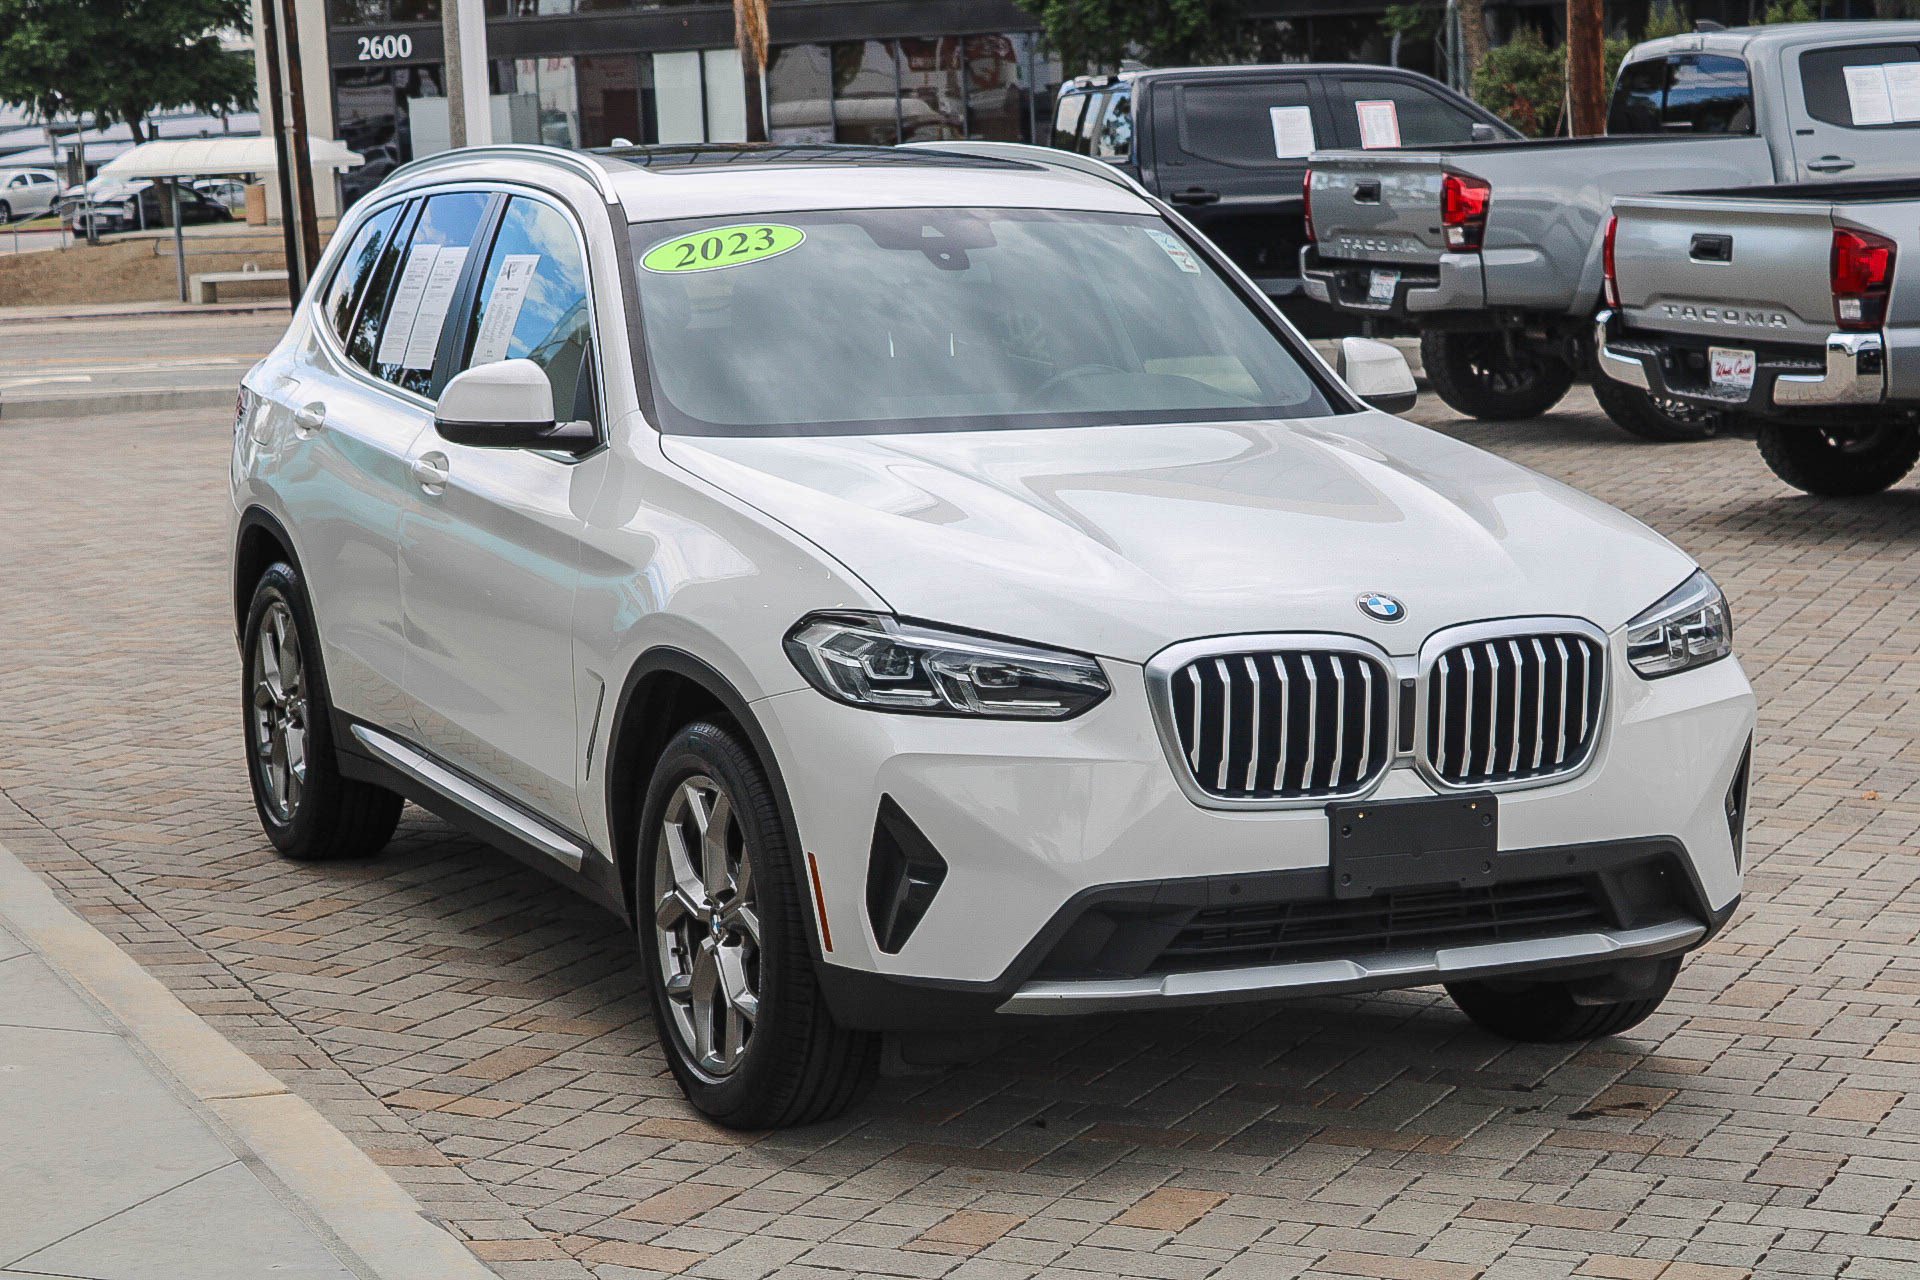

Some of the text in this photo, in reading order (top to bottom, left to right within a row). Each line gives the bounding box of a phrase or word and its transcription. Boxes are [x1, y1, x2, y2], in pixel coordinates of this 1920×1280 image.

[358, 34, 412, 60] 2600
[675, 228, 775, 268] 2023
[1661, 304, 1788, 329] TACOMA
